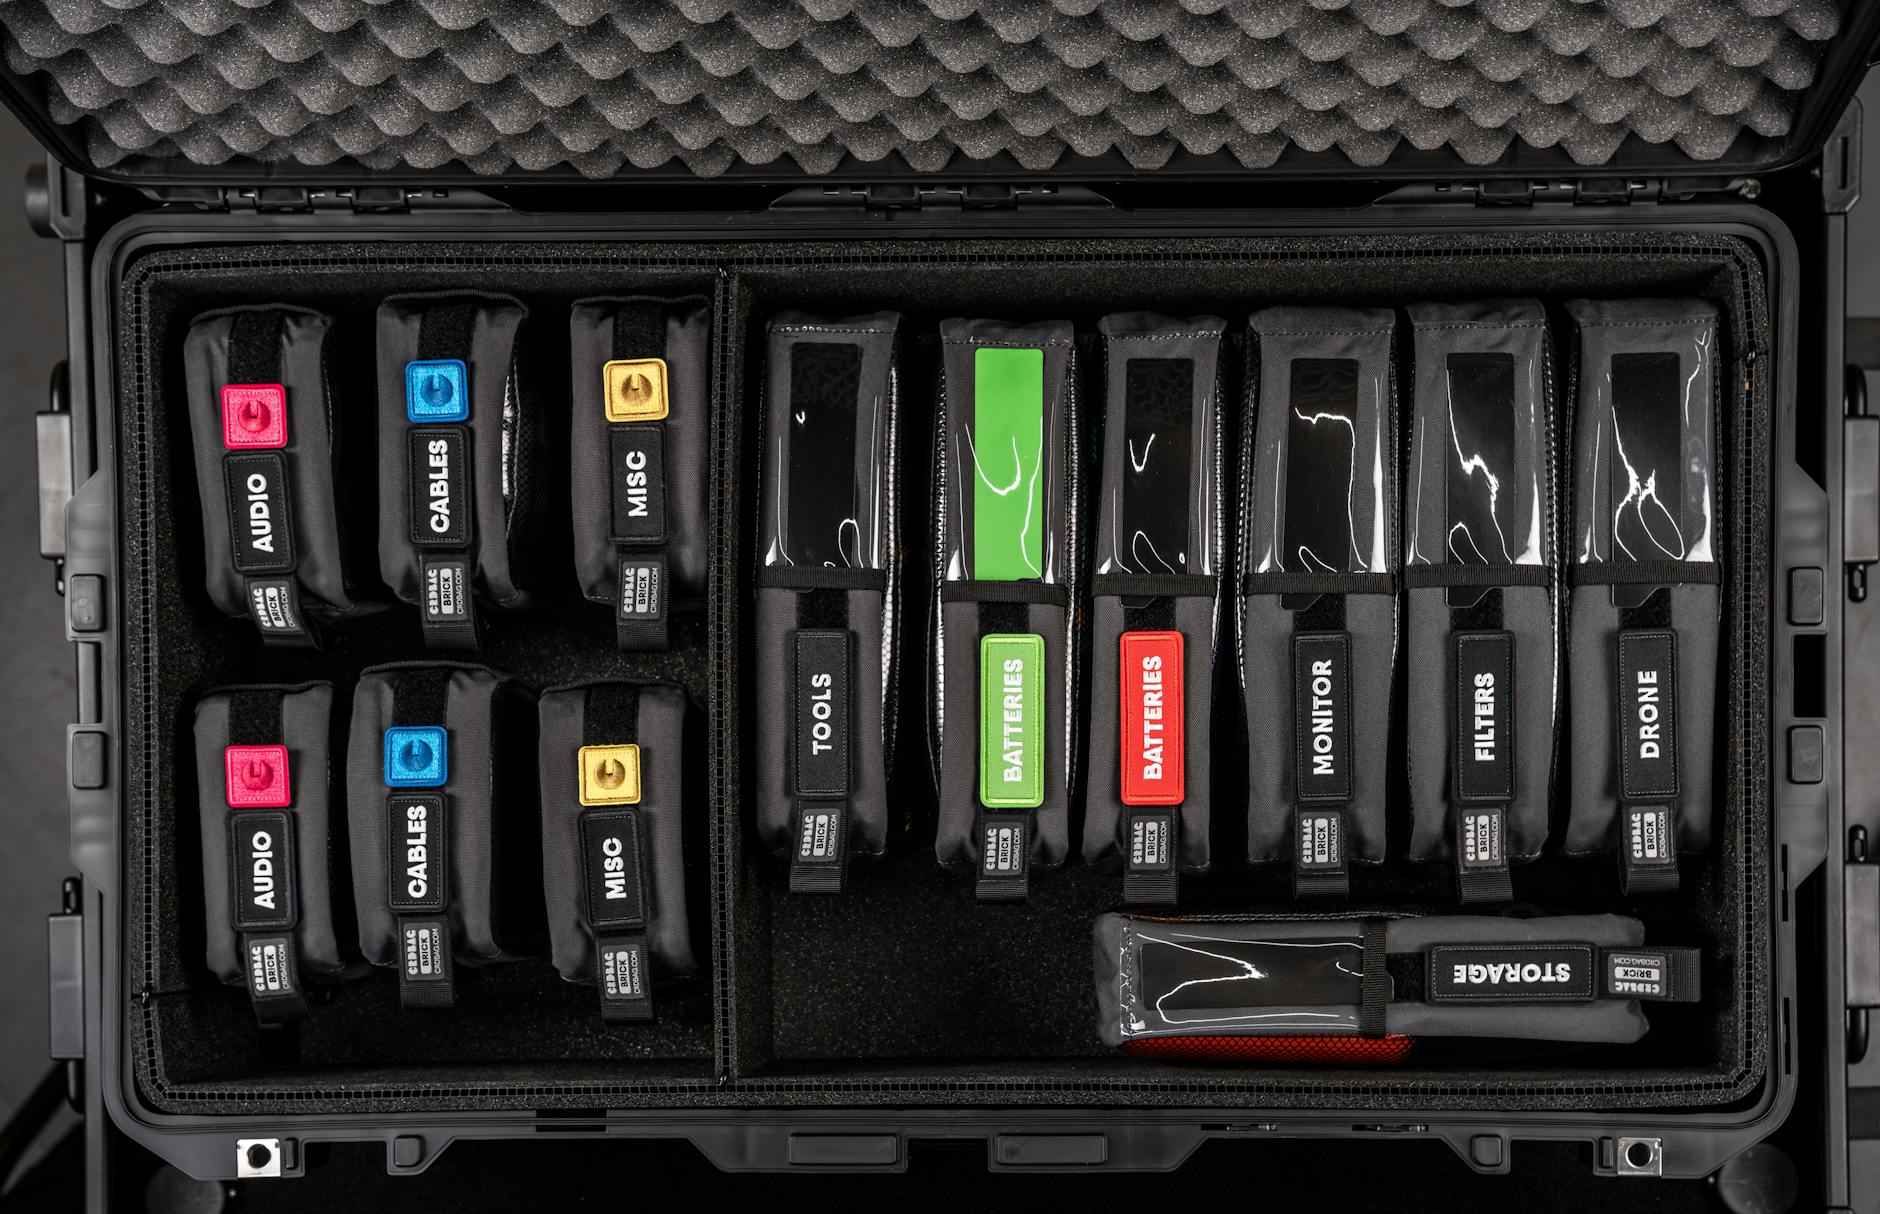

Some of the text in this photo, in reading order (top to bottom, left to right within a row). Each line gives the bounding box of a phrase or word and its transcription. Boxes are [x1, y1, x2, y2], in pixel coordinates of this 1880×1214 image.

[428, 439, 450, 533] CABLES
[625, 450, 649, 517] MISC
[246, 473, 274, 553] AUDIO
[442, 576, 452, 606] BRICK
[638, 576, 647, 605] BRICK
[268, 596, 281, 622] BRICK
[811, 673, 833, 756] TOOLS
[1003, 658, 1024, 783] BATTERIES
[1142, 655, 1164, 780] BATTERIES
[1311, 659, 1335, 775] MONITOR
[1473, 672, 1495, 761] FILTERS
[1637, 670, 1660, 759] DRONE
[816, 823, 826, 849] BRICK
[1000, 836, 1009, 863] BRICK
[1147, 829, 1156, 856] BRICK
[1317, 826, 1326, 855] BRICK
[1479, 823, 1488, 852] BRICK
[1646, 820, 1655, 850] BRICK
[406, 805, 428, 899] CABLES
[251, 830, 276, 910] AUDIO
[602, 837, 627, 900] MISC
[421, 937, 430, 967] BRICK
[266, 954, 277, 983] BRICK
[619, 960, 629, 987] BRICK
[1453, 962, 1571, 985] STORAGE
[1623, 969, 1652, 978] BRICK
